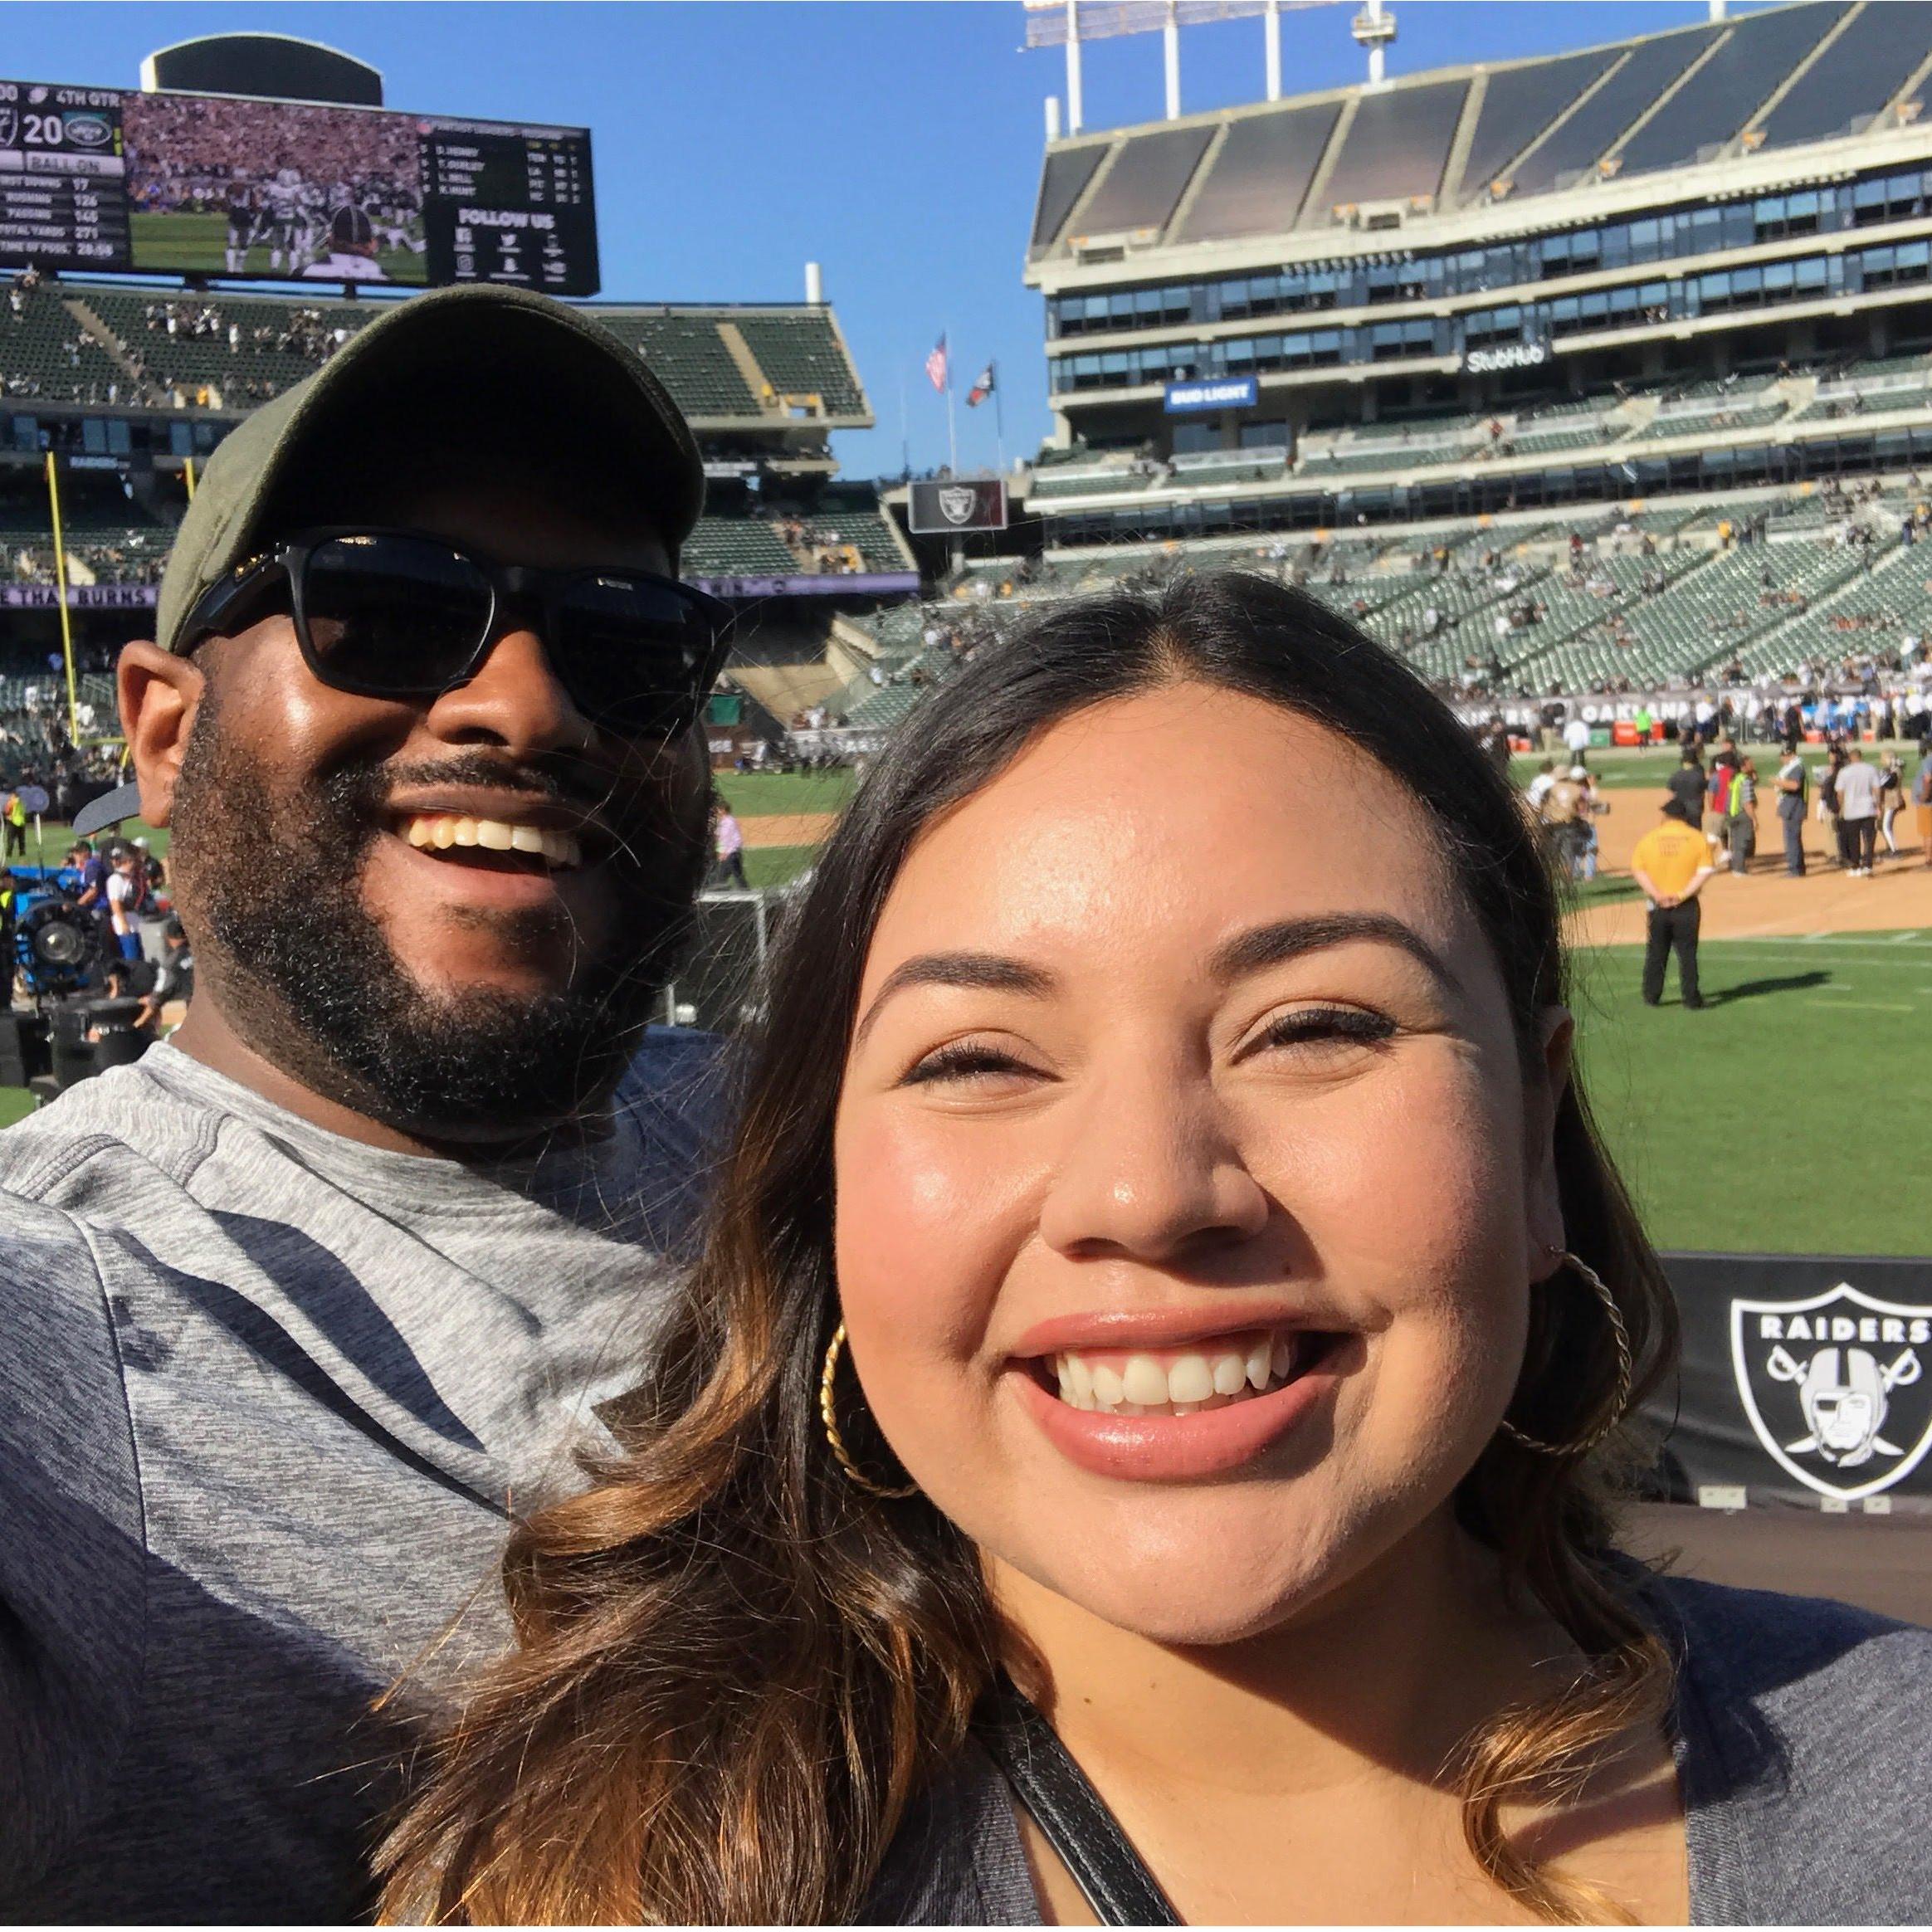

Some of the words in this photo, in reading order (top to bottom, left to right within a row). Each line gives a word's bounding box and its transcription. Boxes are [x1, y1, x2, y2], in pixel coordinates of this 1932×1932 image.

[23, 114, 63, 145] 20
[459, 208, 529, 228] FOLLOW
[530, 212, 555, 230] US
[1467, 344, 1544, 373] StubHub
[1169, 388, 1203, 406] BUD
[1203, 383, 1250, 402] LIGHT
[77, 588, 147, 606] BURNS
[1759, 1314, 1932, 1344] RAIDERS
